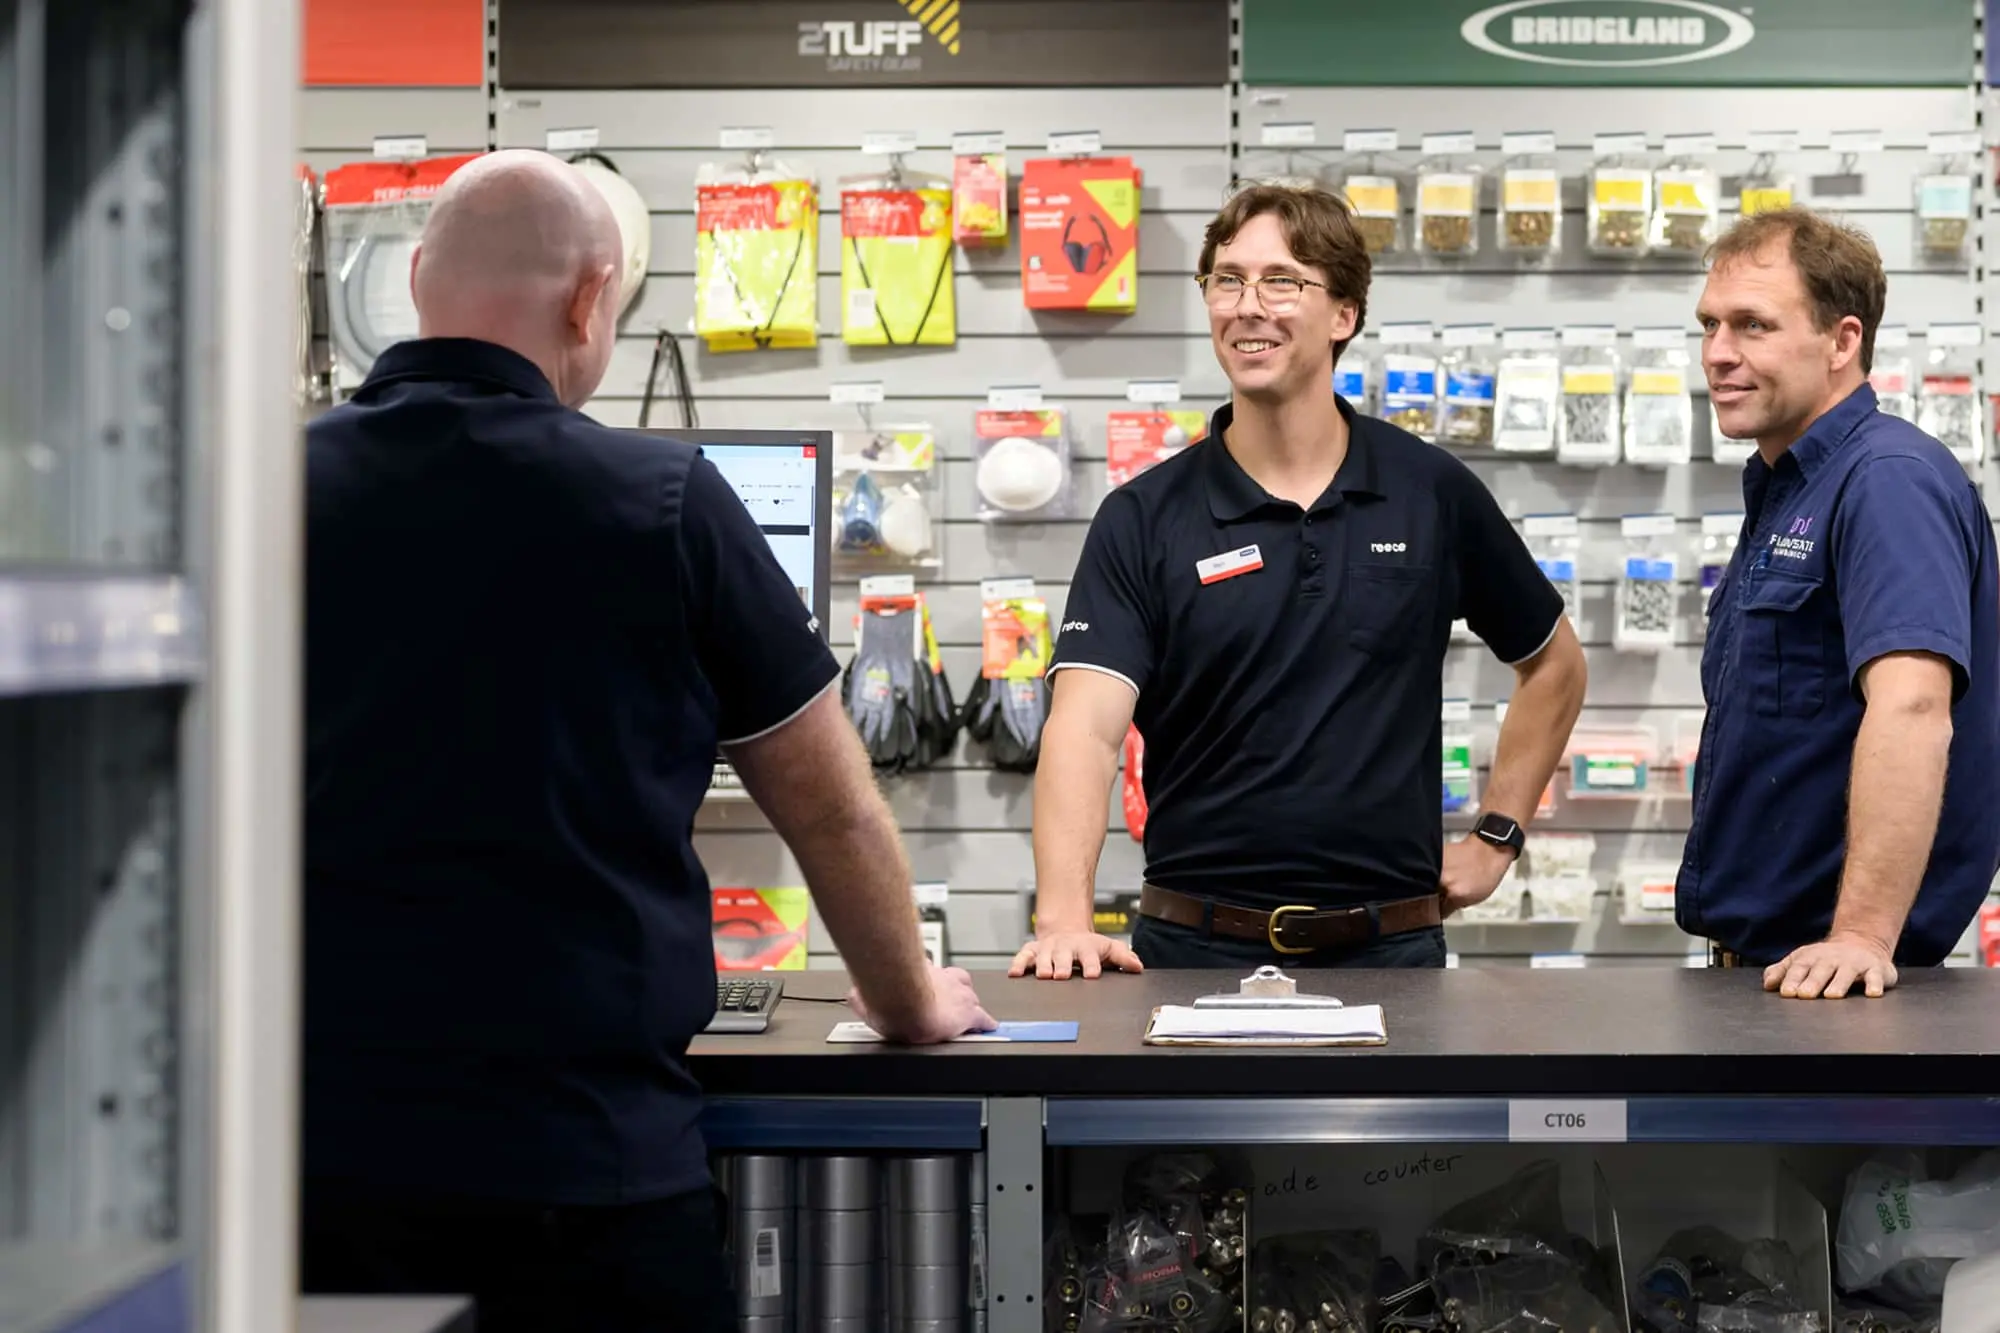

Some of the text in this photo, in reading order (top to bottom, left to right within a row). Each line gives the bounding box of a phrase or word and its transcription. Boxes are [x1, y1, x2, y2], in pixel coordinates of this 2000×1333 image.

[797, 21, 922, 56] 2TUFF
[1511, 16, 1706, 44] BRIDGLAND
[1370, 542, 1407, 553] reece
[1543, 1112, 1586, 1128] CT06
[1363, 1150, 1464, 1187] counter
